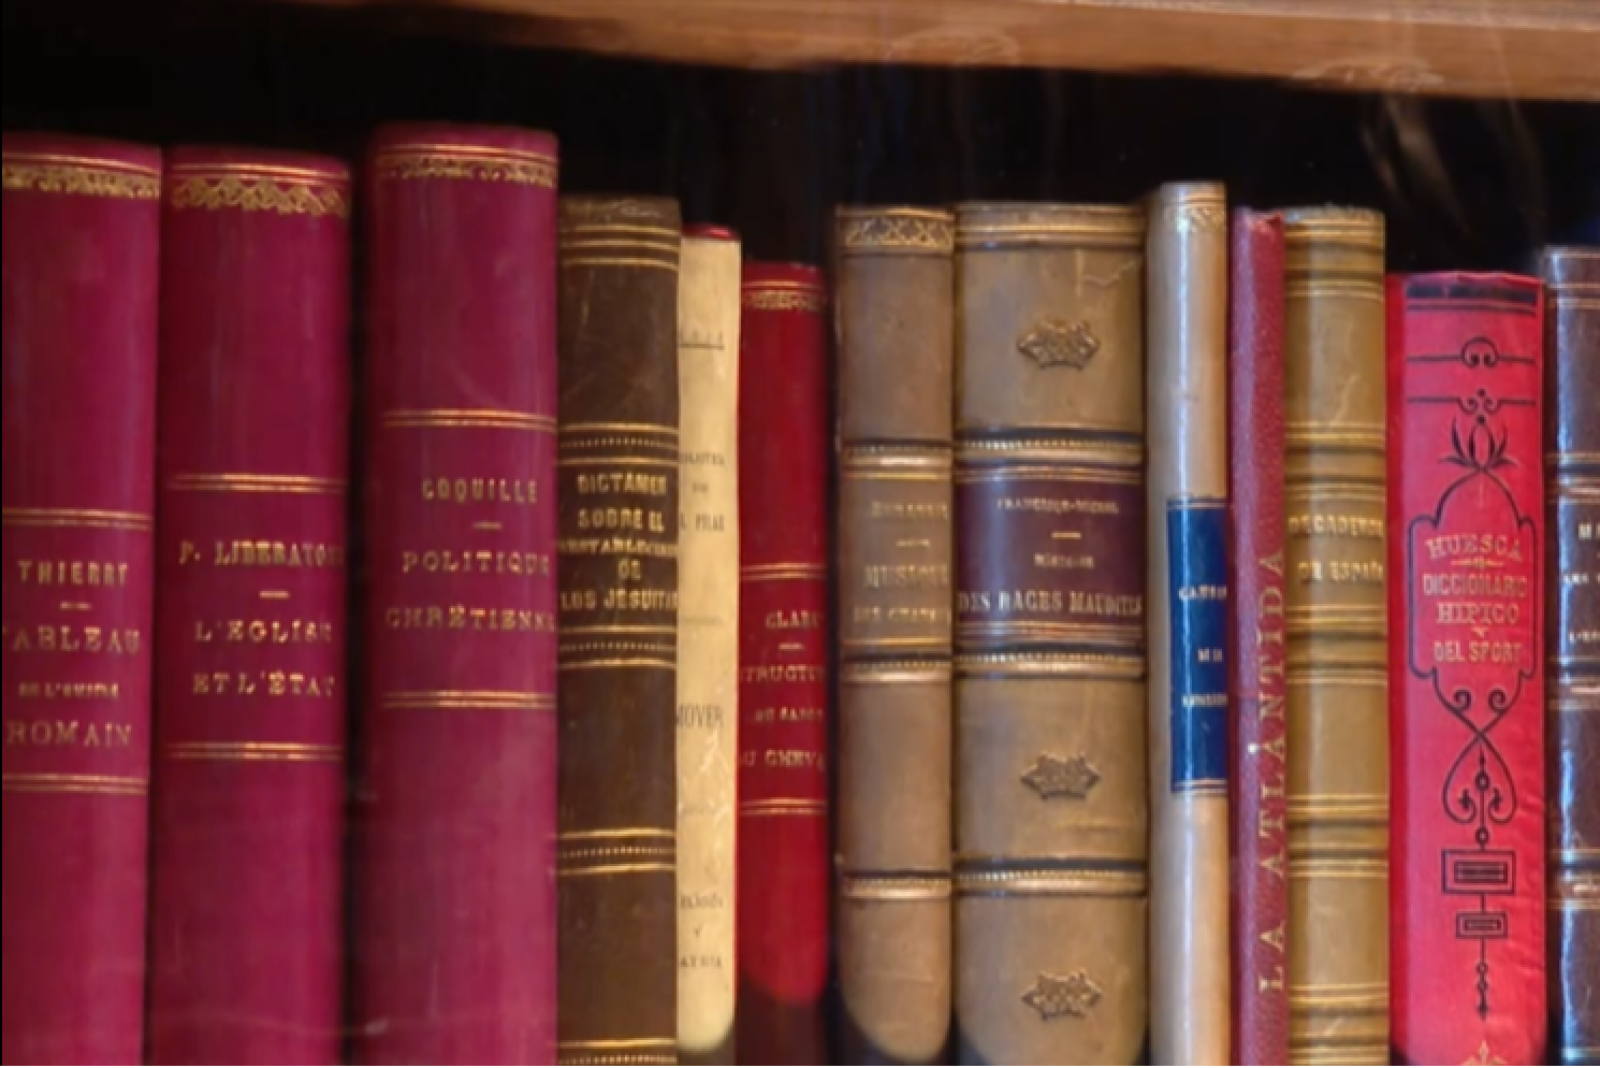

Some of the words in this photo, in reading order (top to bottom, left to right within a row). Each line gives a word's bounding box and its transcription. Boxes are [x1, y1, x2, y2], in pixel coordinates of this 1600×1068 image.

[1424, 533, 1523, 562] HUESCA
[1434, 640, 1465, 662] DEL
[1257, 550, 1286, 880] ATLANTIDA
[1258, 920, 1286, 993] LA
